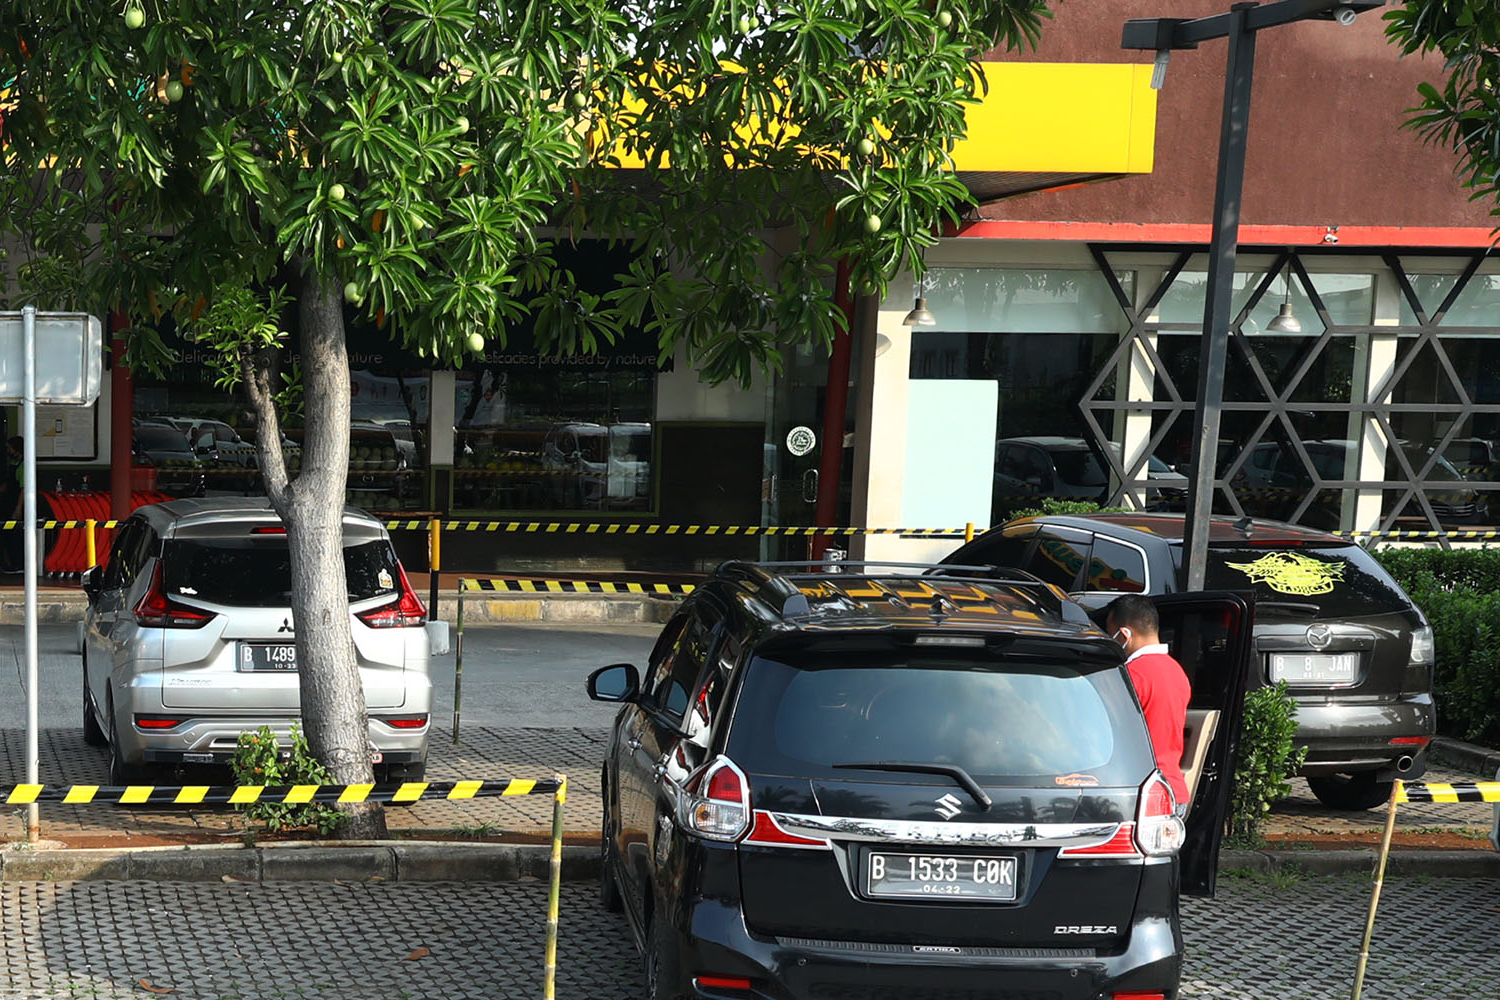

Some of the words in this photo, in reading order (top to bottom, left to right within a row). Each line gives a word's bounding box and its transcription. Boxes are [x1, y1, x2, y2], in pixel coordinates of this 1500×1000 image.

[615, 352, 657, 365] nature
[244, 647, 253, 662] B
[265, 646, 296, 662] 1489
[1276, 657, 1285, 671] B
[1304, 656, 1312, 671] 8
[1328, 656, 1351, 672] JAN
[872, 855, 885, 880] B
[908, 856, 958, 882] 1533
